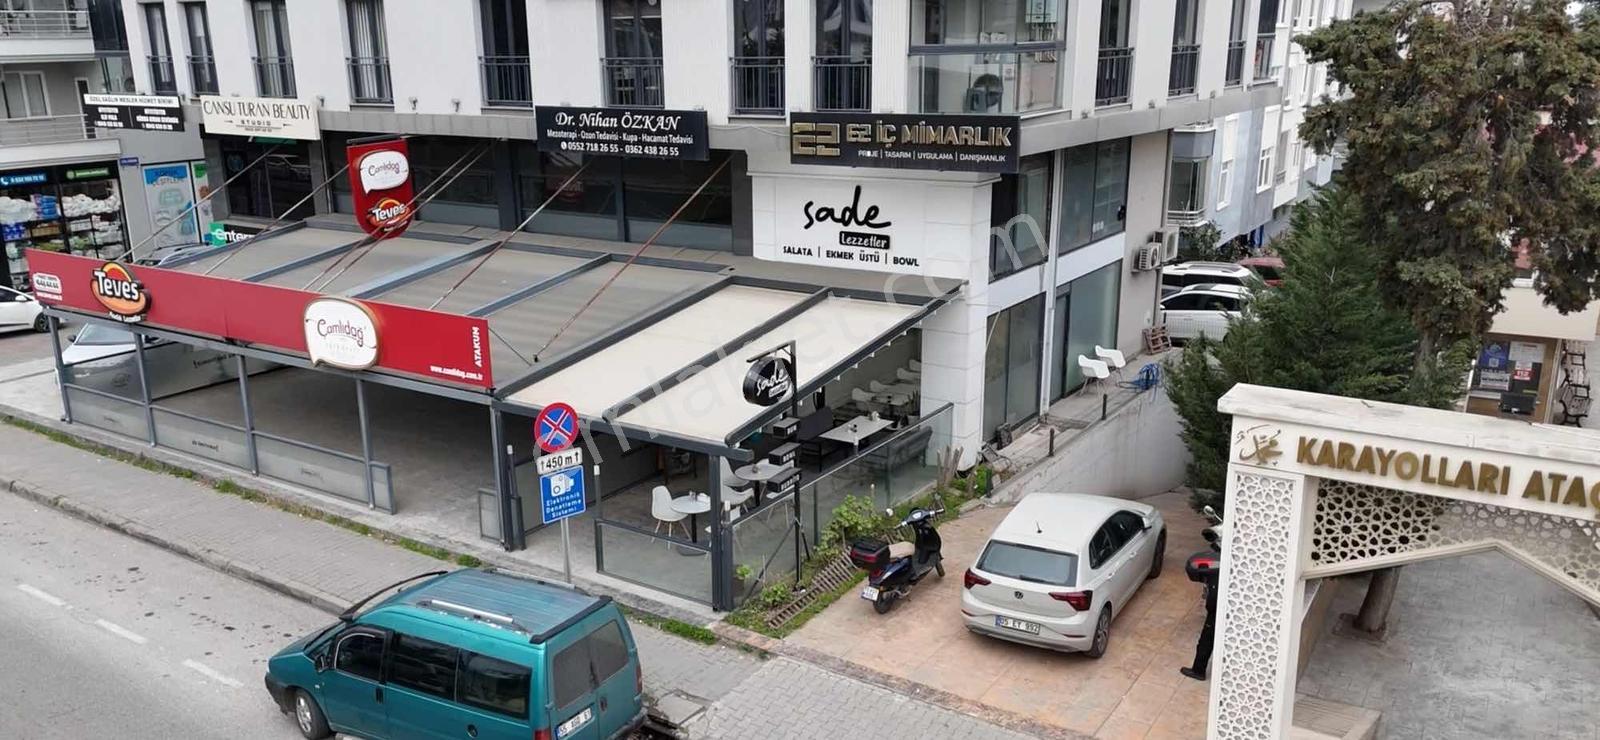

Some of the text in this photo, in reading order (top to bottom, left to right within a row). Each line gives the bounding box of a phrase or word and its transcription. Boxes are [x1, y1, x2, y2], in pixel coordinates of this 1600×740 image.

[203, 100, 311, 120] CANSU TURAN BEAUTY
[556, 111, 681, 131] Dr. Nihan ÖZKAN
[547, 129, 693, 144] Mezoterapi Ozon Tedavisi Kupa Hacamat Tedavisi
[876, 120, 896, 147] İÇ
[902, 120, 1012, 147] MİMARLIK
[568, 142, 679, 156] 0552 718 26 55 0362 438 26 55
[884, 151, 911, 159] TASARIM
[917, 152, 954, 161] UYGULAMA
[959, 152, 1006, 163] DANIŞMANLIK
[372, 203, 406, 221] Teves
[804, 185, 892, 229] sade
[783, 245, 920, 267] SALATA EKMEK ÜSTÜ BOWL
[93, 268, 139, 301] Teves
[472, 326, 483, 368] ATAKUM
[546, 455, 573, 469] 450 m
[1296, 436, 1511, 496] KARAYOLLARI
[546, 491, 580, 506] Elektronik
[546, 499, 582, 514] Denetleme
[552, 506, 577, 519] Sistemi
